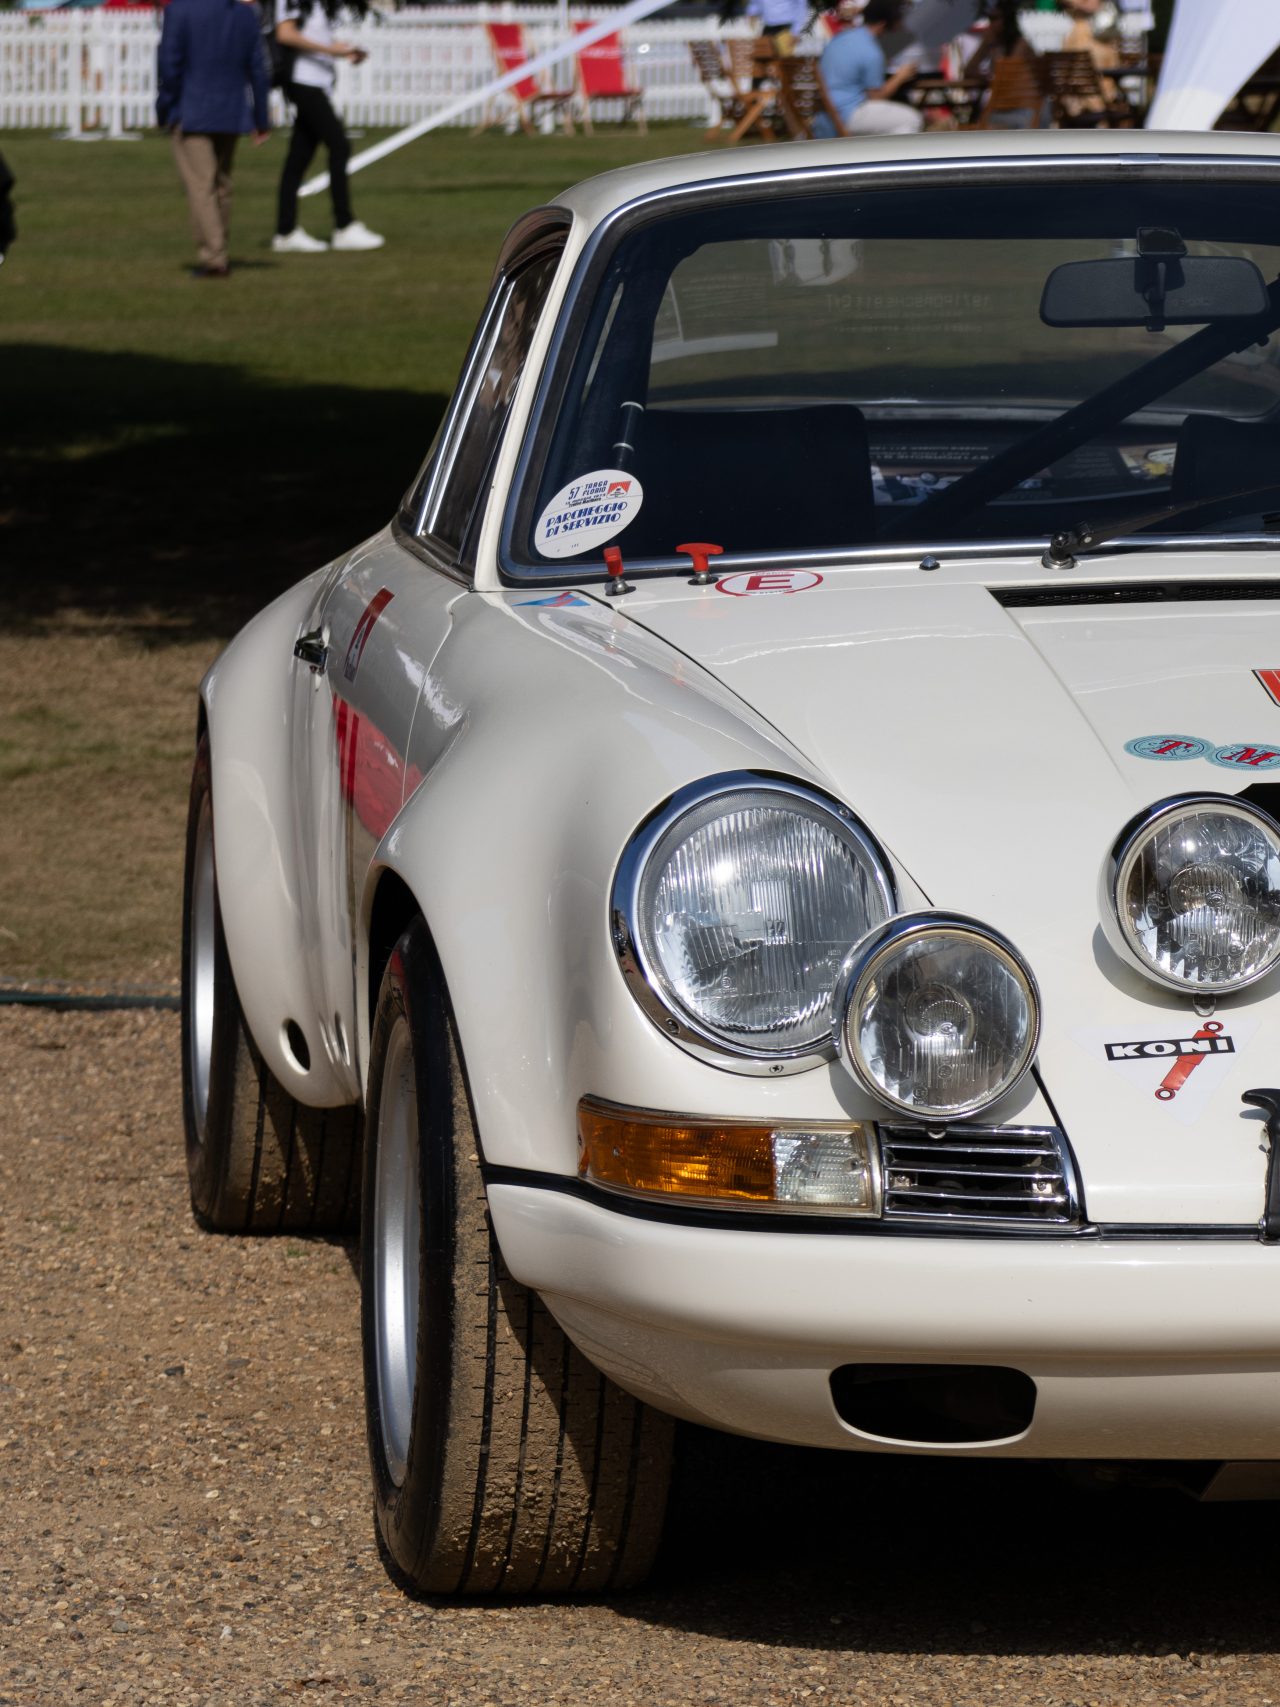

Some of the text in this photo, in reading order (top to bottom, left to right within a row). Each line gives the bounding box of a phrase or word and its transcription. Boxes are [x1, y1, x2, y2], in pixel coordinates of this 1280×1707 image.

[582, 487, 606, 497] FLORIO
[585, 480, 608, 490] TARGA
[546, 501, 628, 528] PARCHEGGIO
[546, 513, 621, 538] DI SERVIZIO
[746, 574, 795, 591] E
[1111, 1039, 1229, 1058] KONI
